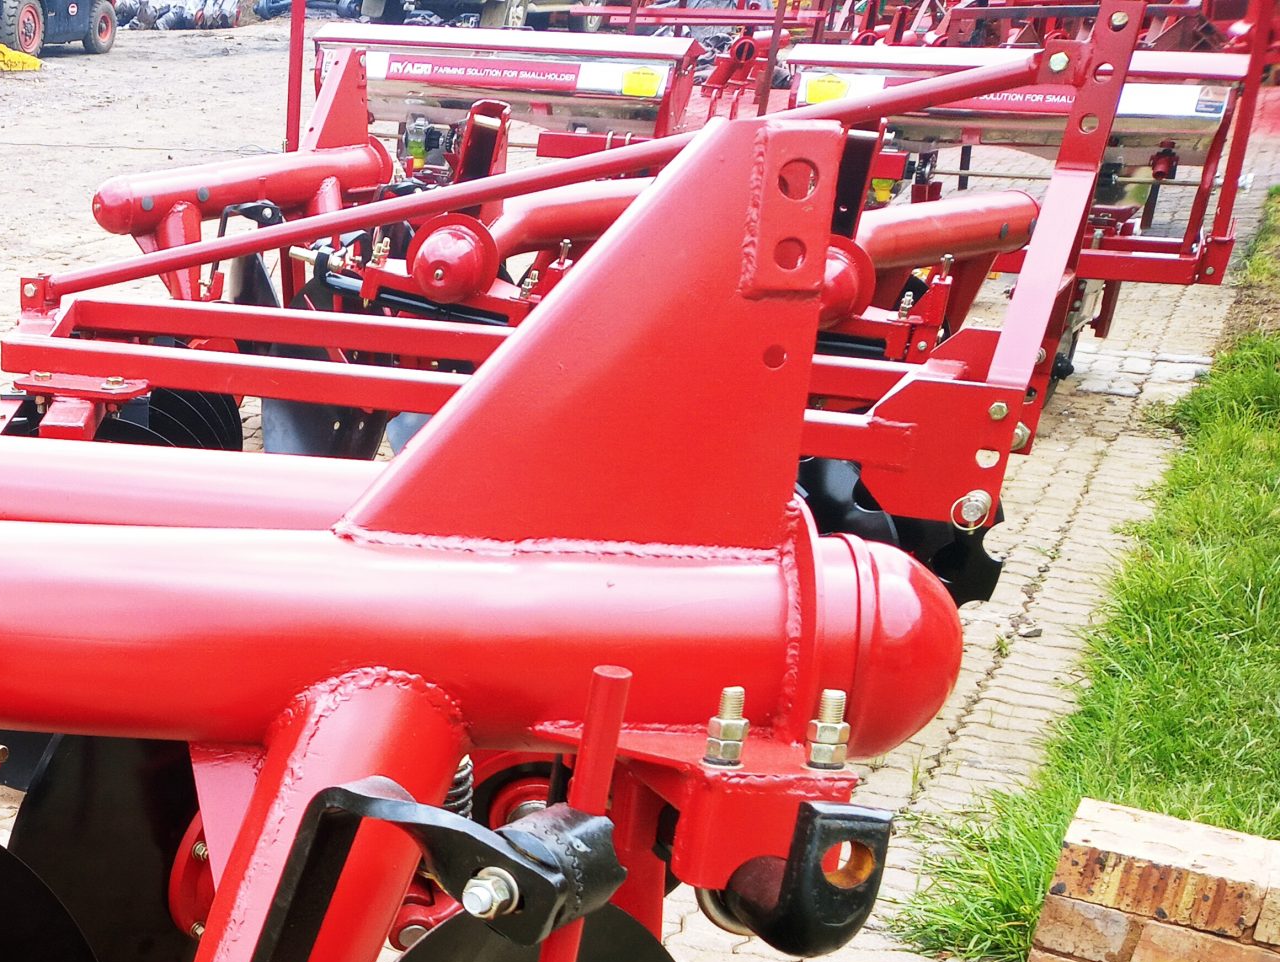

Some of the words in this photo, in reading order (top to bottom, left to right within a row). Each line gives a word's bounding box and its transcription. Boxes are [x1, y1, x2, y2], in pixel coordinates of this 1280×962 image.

[433, 65, 465, 75] FARMING
[466, 67, 502, 77] SOLUTION
[503, 69, 518, 77] FOR
[519, 70, 576, 81] SMALLHOLDER
[1024, 94, 1043, 102] FOR
